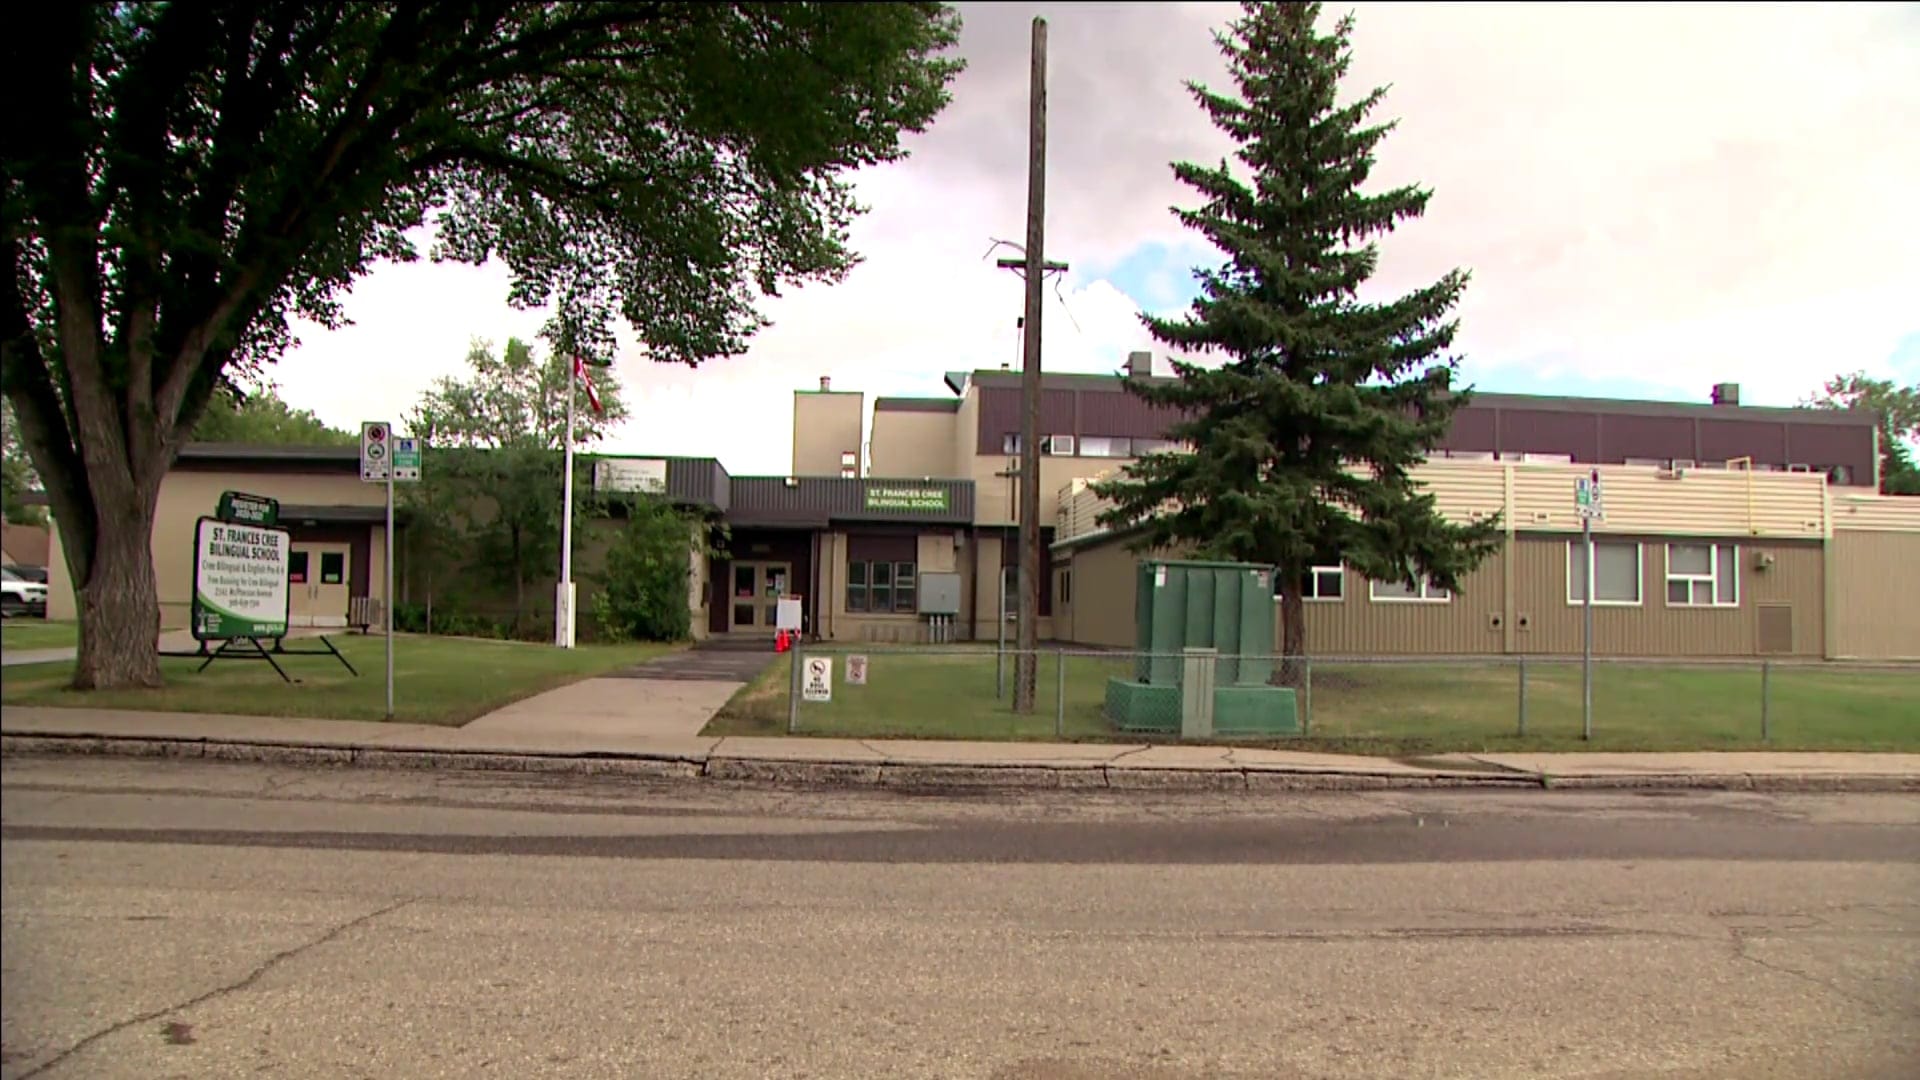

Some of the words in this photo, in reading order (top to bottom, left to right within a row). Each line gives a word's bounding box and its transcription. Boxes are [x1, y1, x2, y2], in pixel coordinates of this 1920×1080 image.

[882, 489, 921, 498] FRANCES
[921, 490, 943, 498] CREE
[867, 498, 910, 506] BILINGUAL
[911, 499, 945, 508] SCHOOL
[213, 527, 225, 541] ST.
[227, 529, 260, 545] FRANCES
[262, 533, 279, 547] CREE
[209, 542, 250, 559] BILINGUAL
[251, 546, 280, 561] SCHOOL
[217, 560, 241, 573] Bilingual
[247, 562, 266, 575] English
[259, 578, 279, 588] Bilingual
